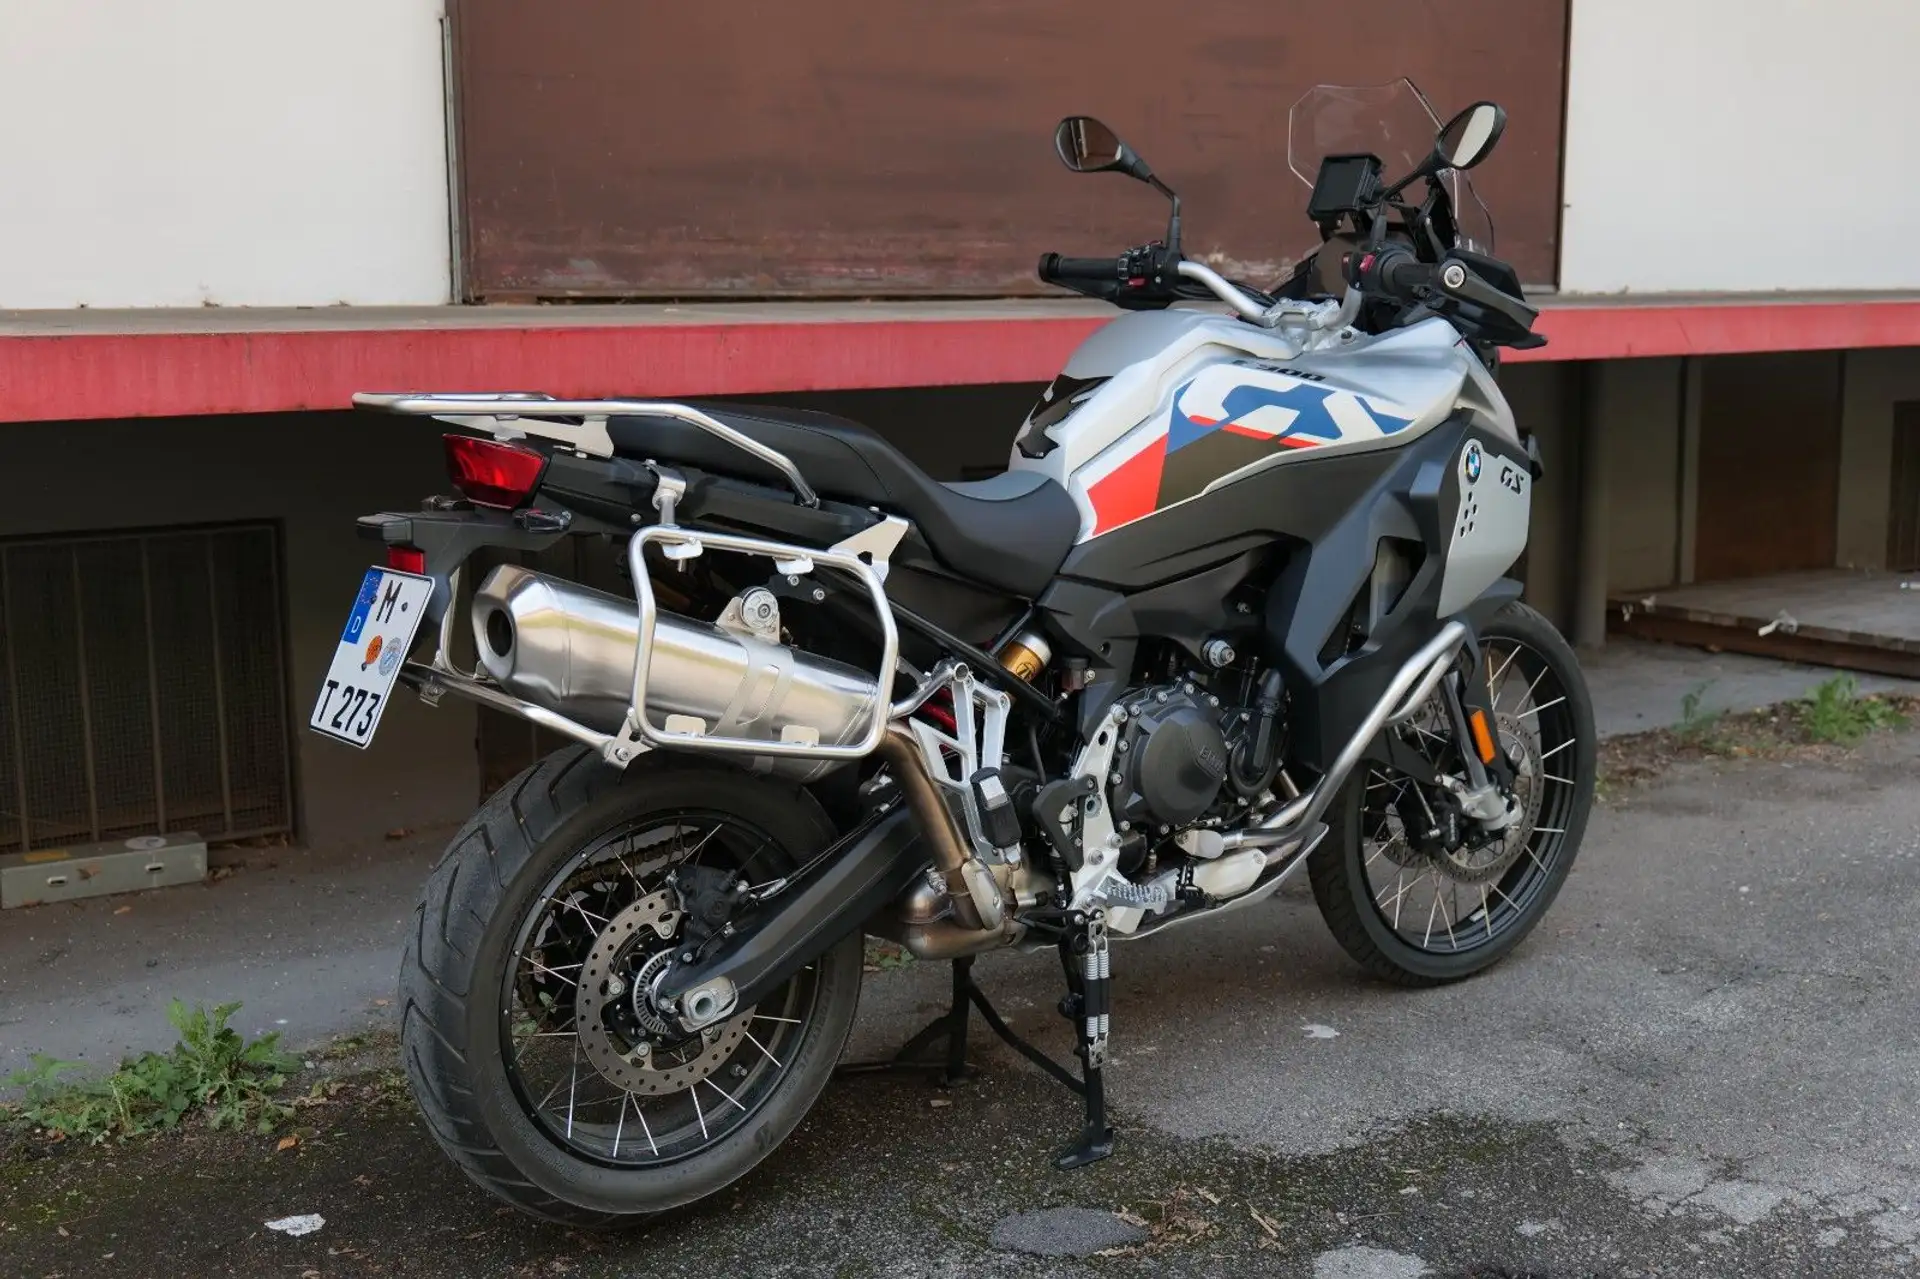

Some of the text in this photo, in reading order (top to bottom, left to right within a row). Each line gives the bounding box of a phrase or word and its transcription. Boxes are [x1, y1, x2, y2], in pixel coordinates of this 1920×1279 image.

[1500, 466, 1524, 495] GS
[375, 579, 404, 624] M
[351, 616, 362, 634] D
[318, 679, 381, 737] T 273
